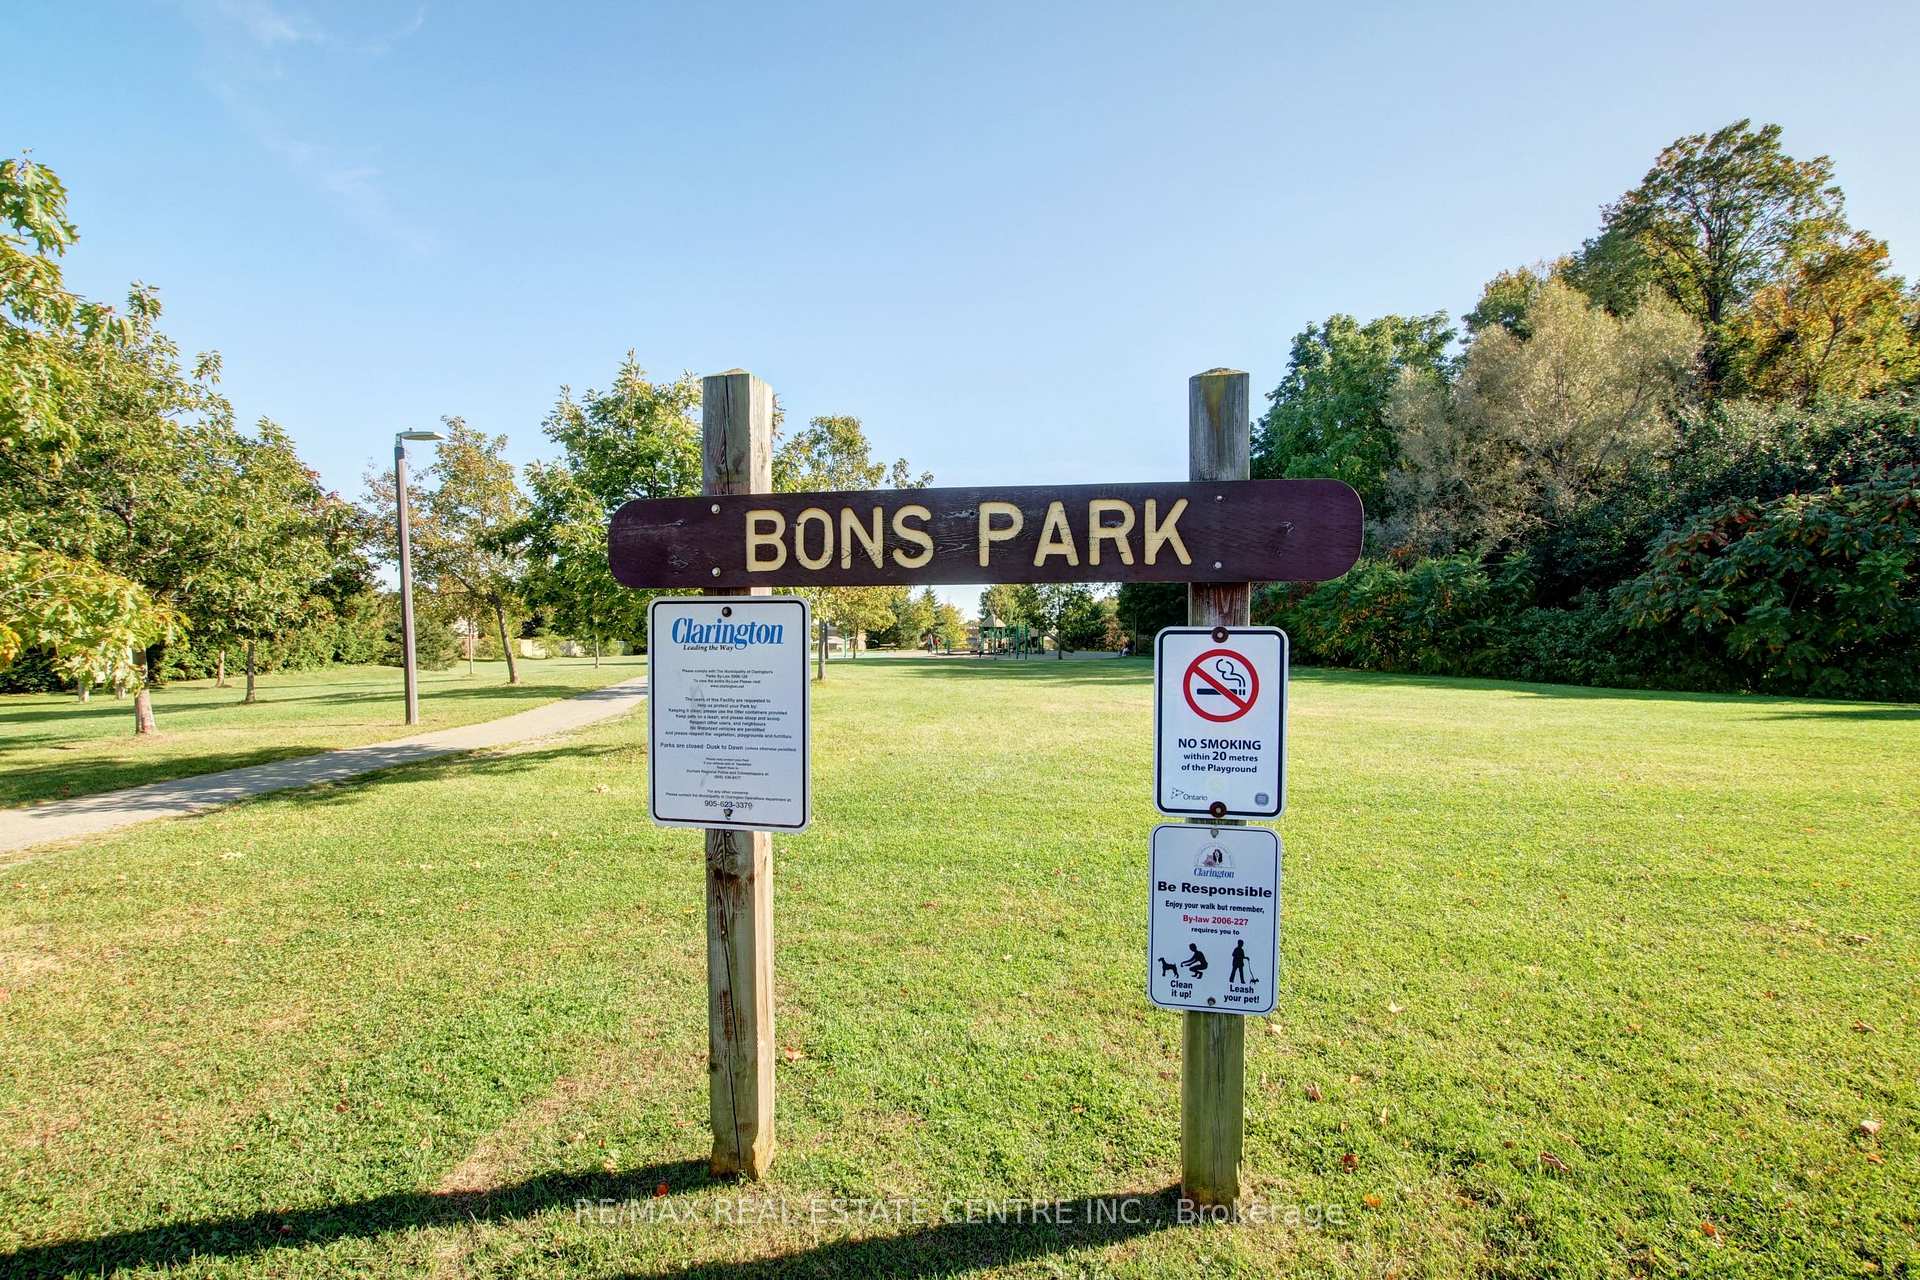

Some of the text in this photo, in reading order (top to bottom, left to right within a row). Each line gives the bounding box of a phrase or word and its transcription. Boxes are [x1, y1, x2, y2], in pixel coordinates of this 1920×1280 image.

[745, 498, 1193, 573] BONS PARK
[672, 618, 784, 650] Clarington
[1178, 738, 1262, 750] NO SMOKING
[1184, 752, 1258, 762] within 20 metres
[1182, 763, 1257, 774] of the Playground
[1183, 793, 1208, 801] Ontario
[1194, 868, 1234, 879] Clarington
[1158, 881, 1272, 898] Be Responsible
[1165, 900, 1182, 909] Enjoy
[1200, 902, 1215, 910] walk
[1217, 903, 1228, 911] but
[1229, 904, 1264, 914] remember,
[1183, 915, 1248, 926] By-law 2006-227
[1191, 927, 1218, 935] requires
[1170, 980, 1193, 989] Clean
[1230, 984, 1254, 994] Leash
[1172, 989, 1192, 998] it up!
[1224, 994, 1260, 1004] your pet!
